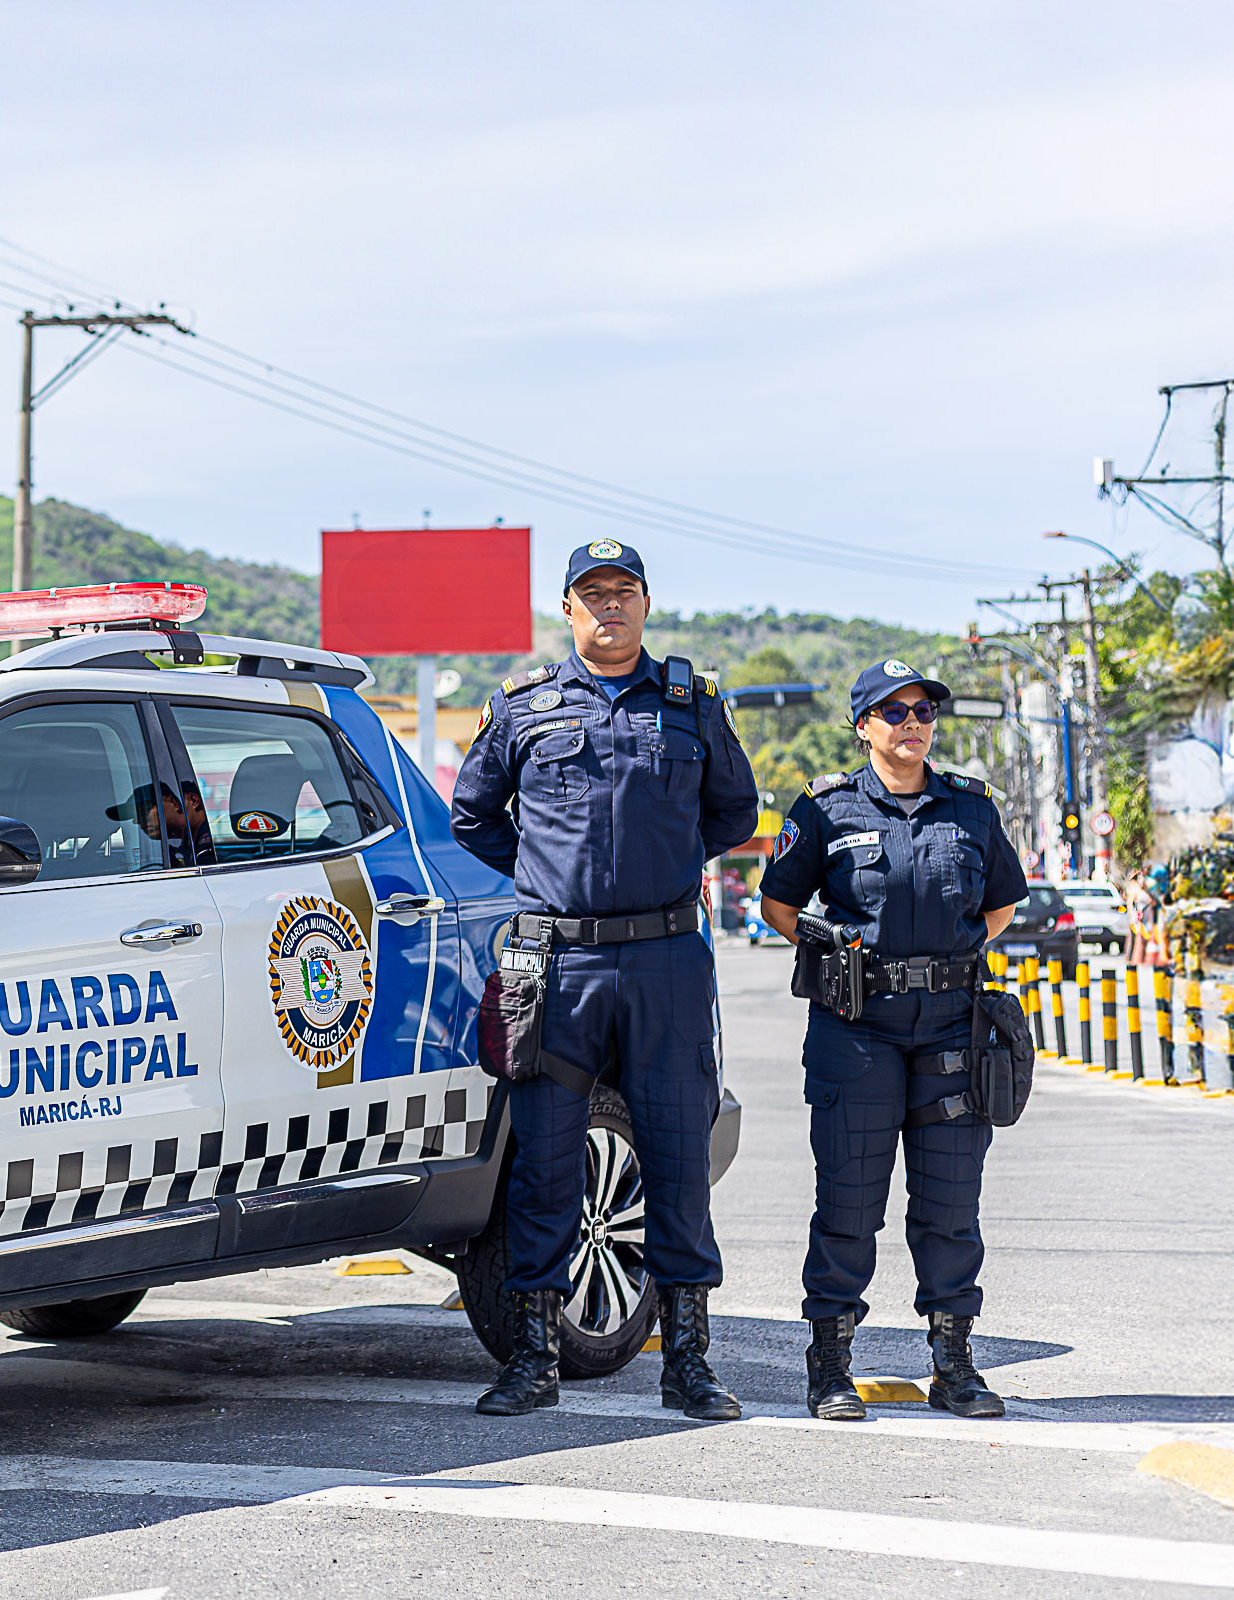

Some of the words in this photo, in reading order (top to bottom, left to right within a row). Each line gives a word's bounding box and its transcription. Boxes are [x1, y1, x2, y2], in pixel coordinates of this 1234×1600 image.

[283, 919, 310, 955] GUARDA
[310, 917, 347, 949] MUNICIPAL
[302, 1021, 346, 1047] MARICÁ
[19, 1094, 123, 1127] MARICÁ-RJ
